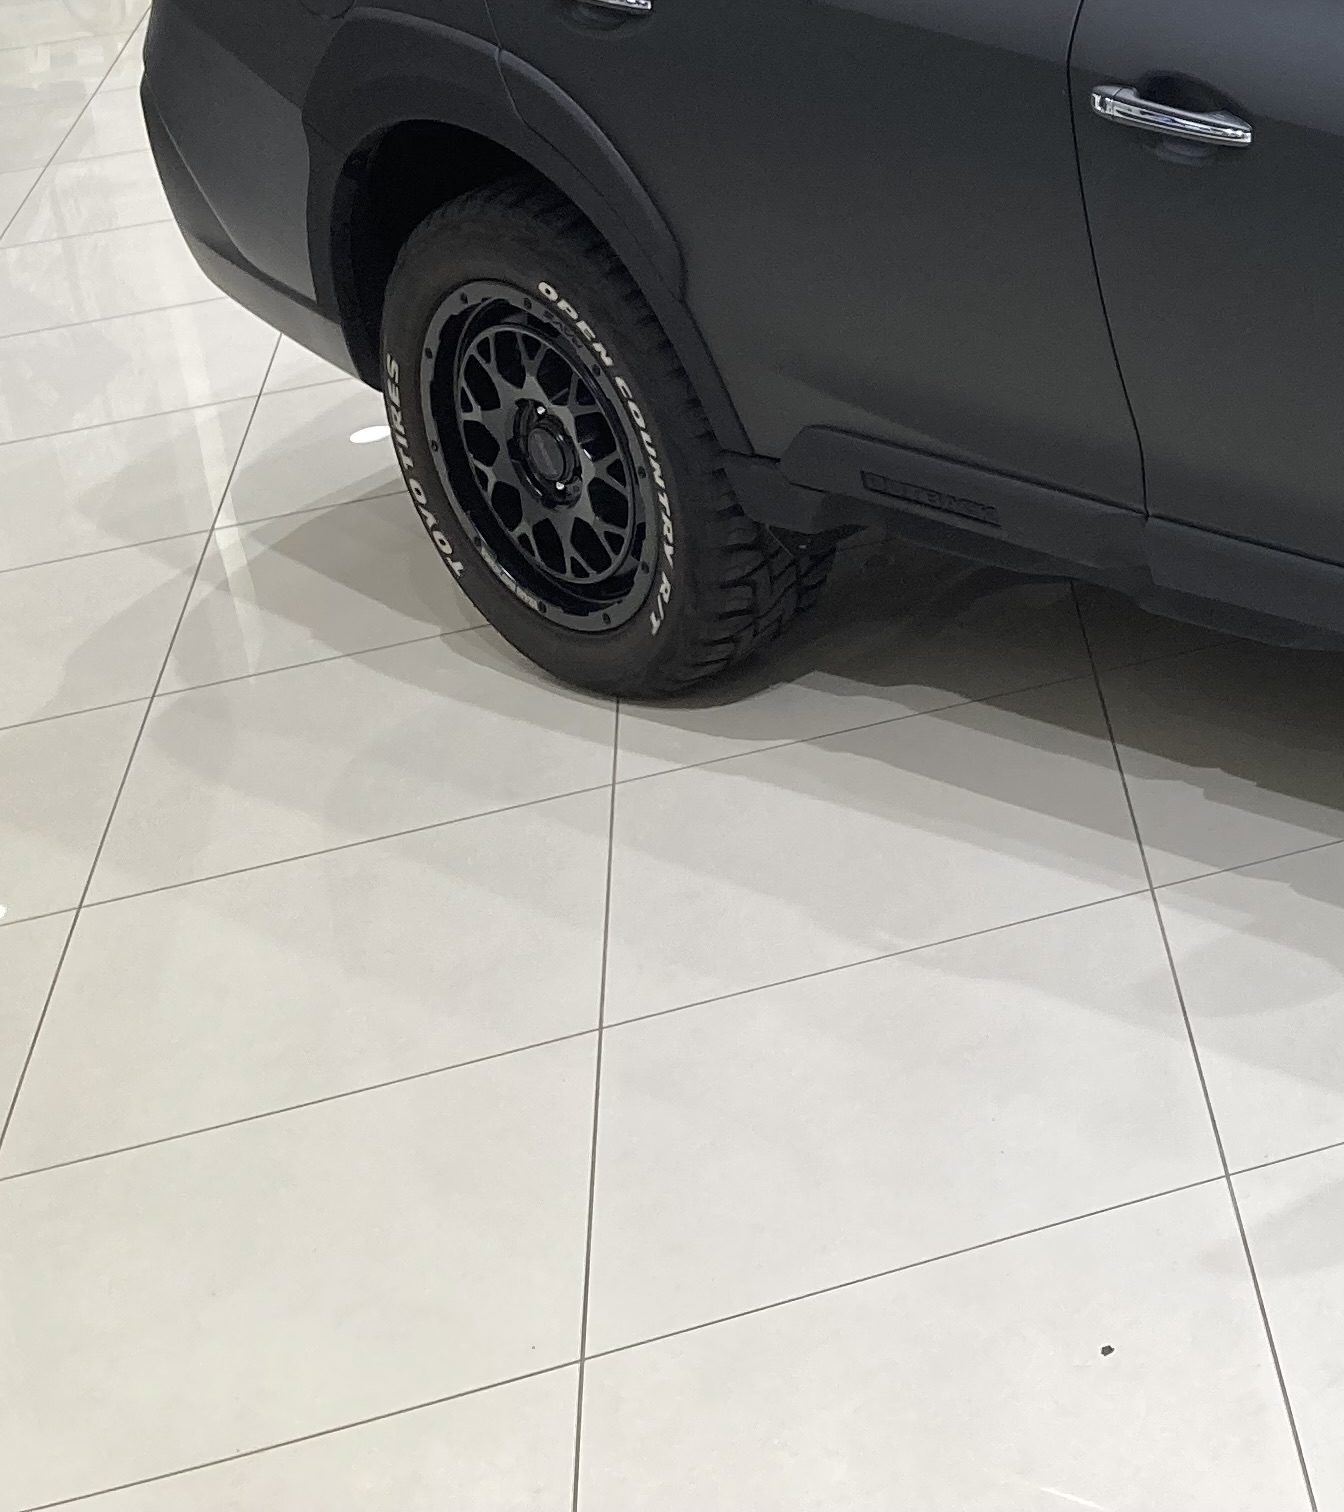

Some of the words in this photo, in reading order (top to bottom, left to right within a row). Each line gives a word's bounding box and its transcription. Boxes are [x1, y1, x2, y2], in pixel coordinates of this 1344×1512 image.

[386, 353, 414, 470] TIRES
[537, 281, 614, 367] OPEN
[614, 375, 675, 569] COUNTRY
[649, 571, 672, 637] R/T
[409, 478, 465, 577] TOYO
